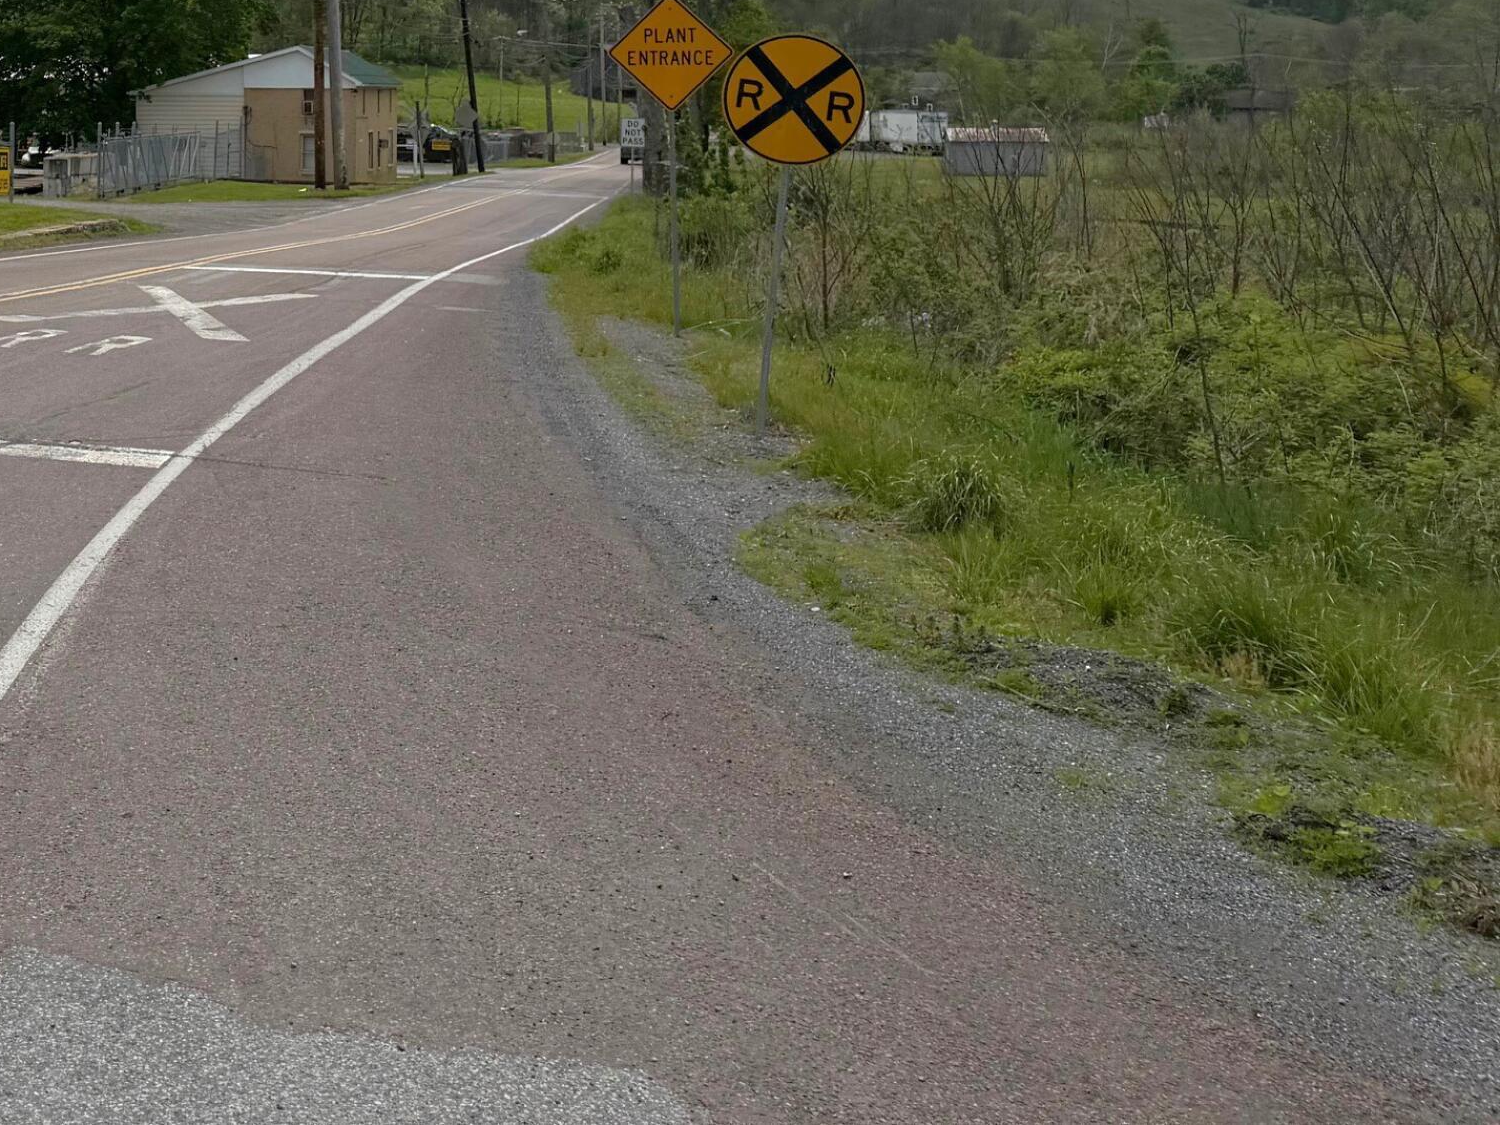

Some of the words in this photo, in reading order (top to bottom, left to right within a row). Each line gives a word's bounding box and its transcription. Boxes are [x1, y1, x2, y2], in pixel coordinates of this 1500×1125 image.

[644, 28, 697, 43] PLANT
[627, 50, 714, 66] ENTRANCE
[736, 78, 764, 111] R
[826, 90, 855, 124] R
[627, 120, 639, 128] DO
[622, 137, 644, 145] PASS
